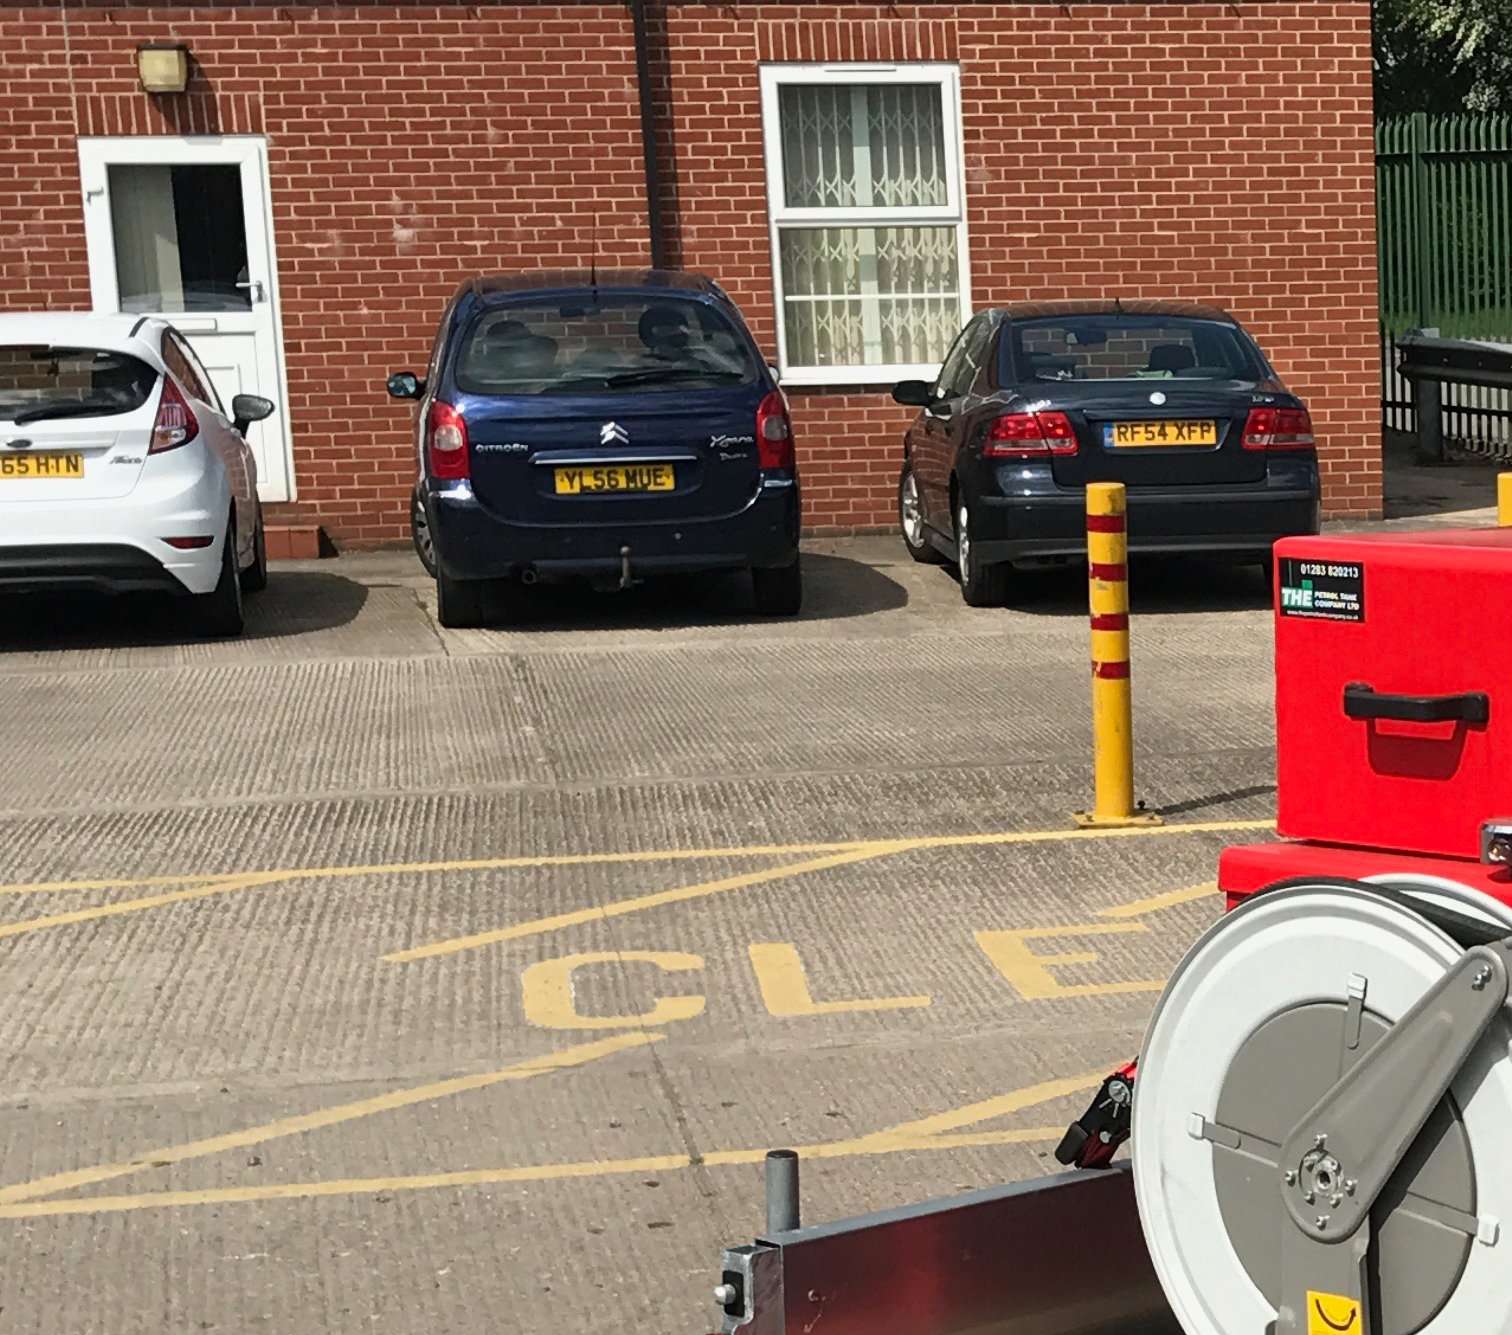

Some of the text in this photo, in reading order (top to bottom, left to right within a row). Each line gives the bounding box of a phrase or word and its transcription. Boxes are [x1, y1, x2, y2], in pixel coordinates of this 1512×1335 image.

[1115, 421, 1213, 442] RF54 XFP
[1, 453, 80, 475] 65 HTN
[563, 467, 666, 491] YL56 MUE
[1281, 588, 1313, 607] THE
